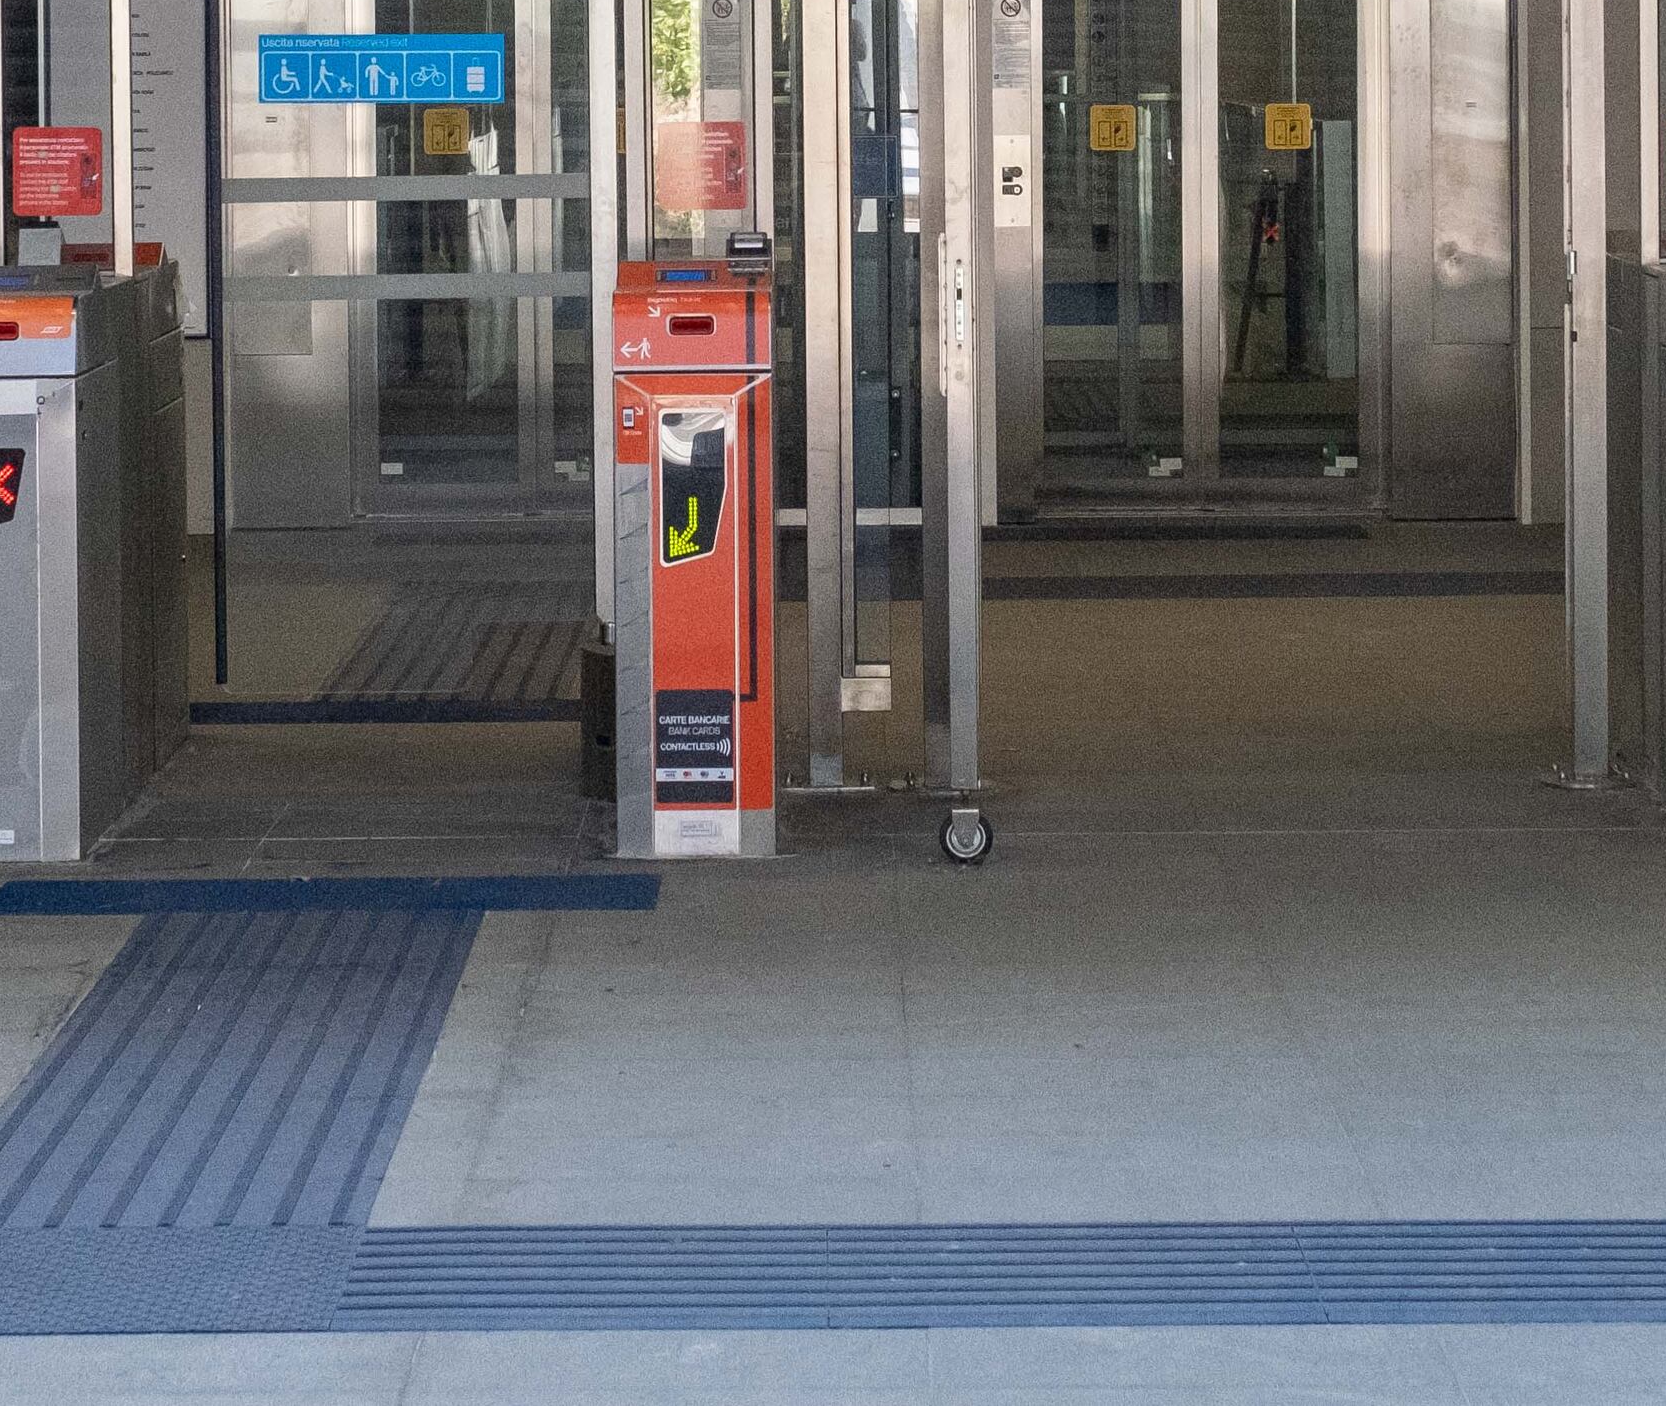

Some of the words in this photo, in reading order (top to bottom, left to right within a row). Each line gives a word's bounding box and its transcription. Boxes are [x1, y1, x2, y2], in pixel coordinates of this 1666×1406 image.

[261, 37, 293, 48] Uscita
[295, 37, 340, 48] riservata
[390, 37, 408, 48] exit
[658, 715, 687, 725] CARTE
[688, 715, 730, 725] BANCARIE
[668, 726, 691, 736] BANK
[692, 726, 721, 736] CARDS
[660, 741, 716, 752] CONTACTLESS
